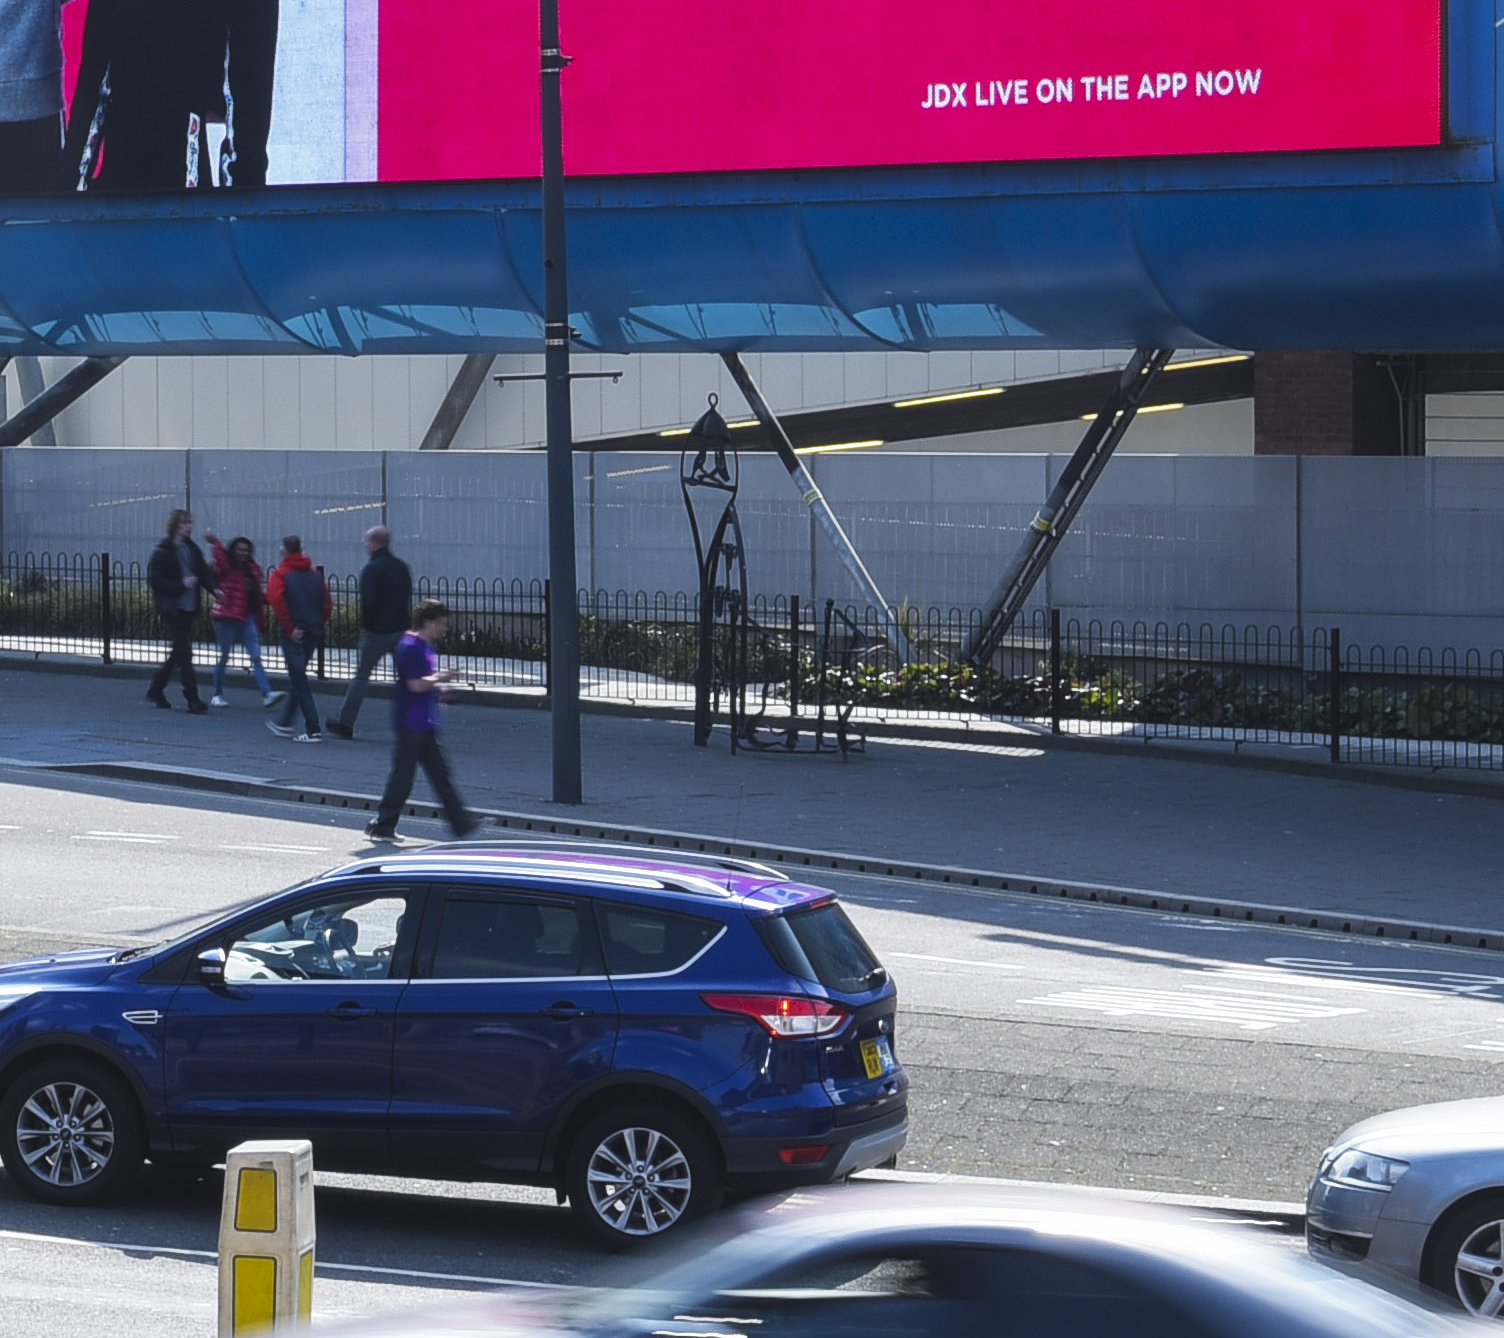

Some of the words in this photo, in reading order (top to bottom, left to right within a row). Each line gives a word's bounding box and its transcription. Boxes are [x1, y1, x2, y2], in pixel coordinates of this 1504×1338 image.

[921, 80, 968, 110] JDX
[974, 79, 1030, 107] LIVE
[1036, 77, 1077, 104] ON
[1081, 75, 1130, 102] THE
[1136, 72, 1189, 99] APP
[1194, 69, 1263, 98] NOW
